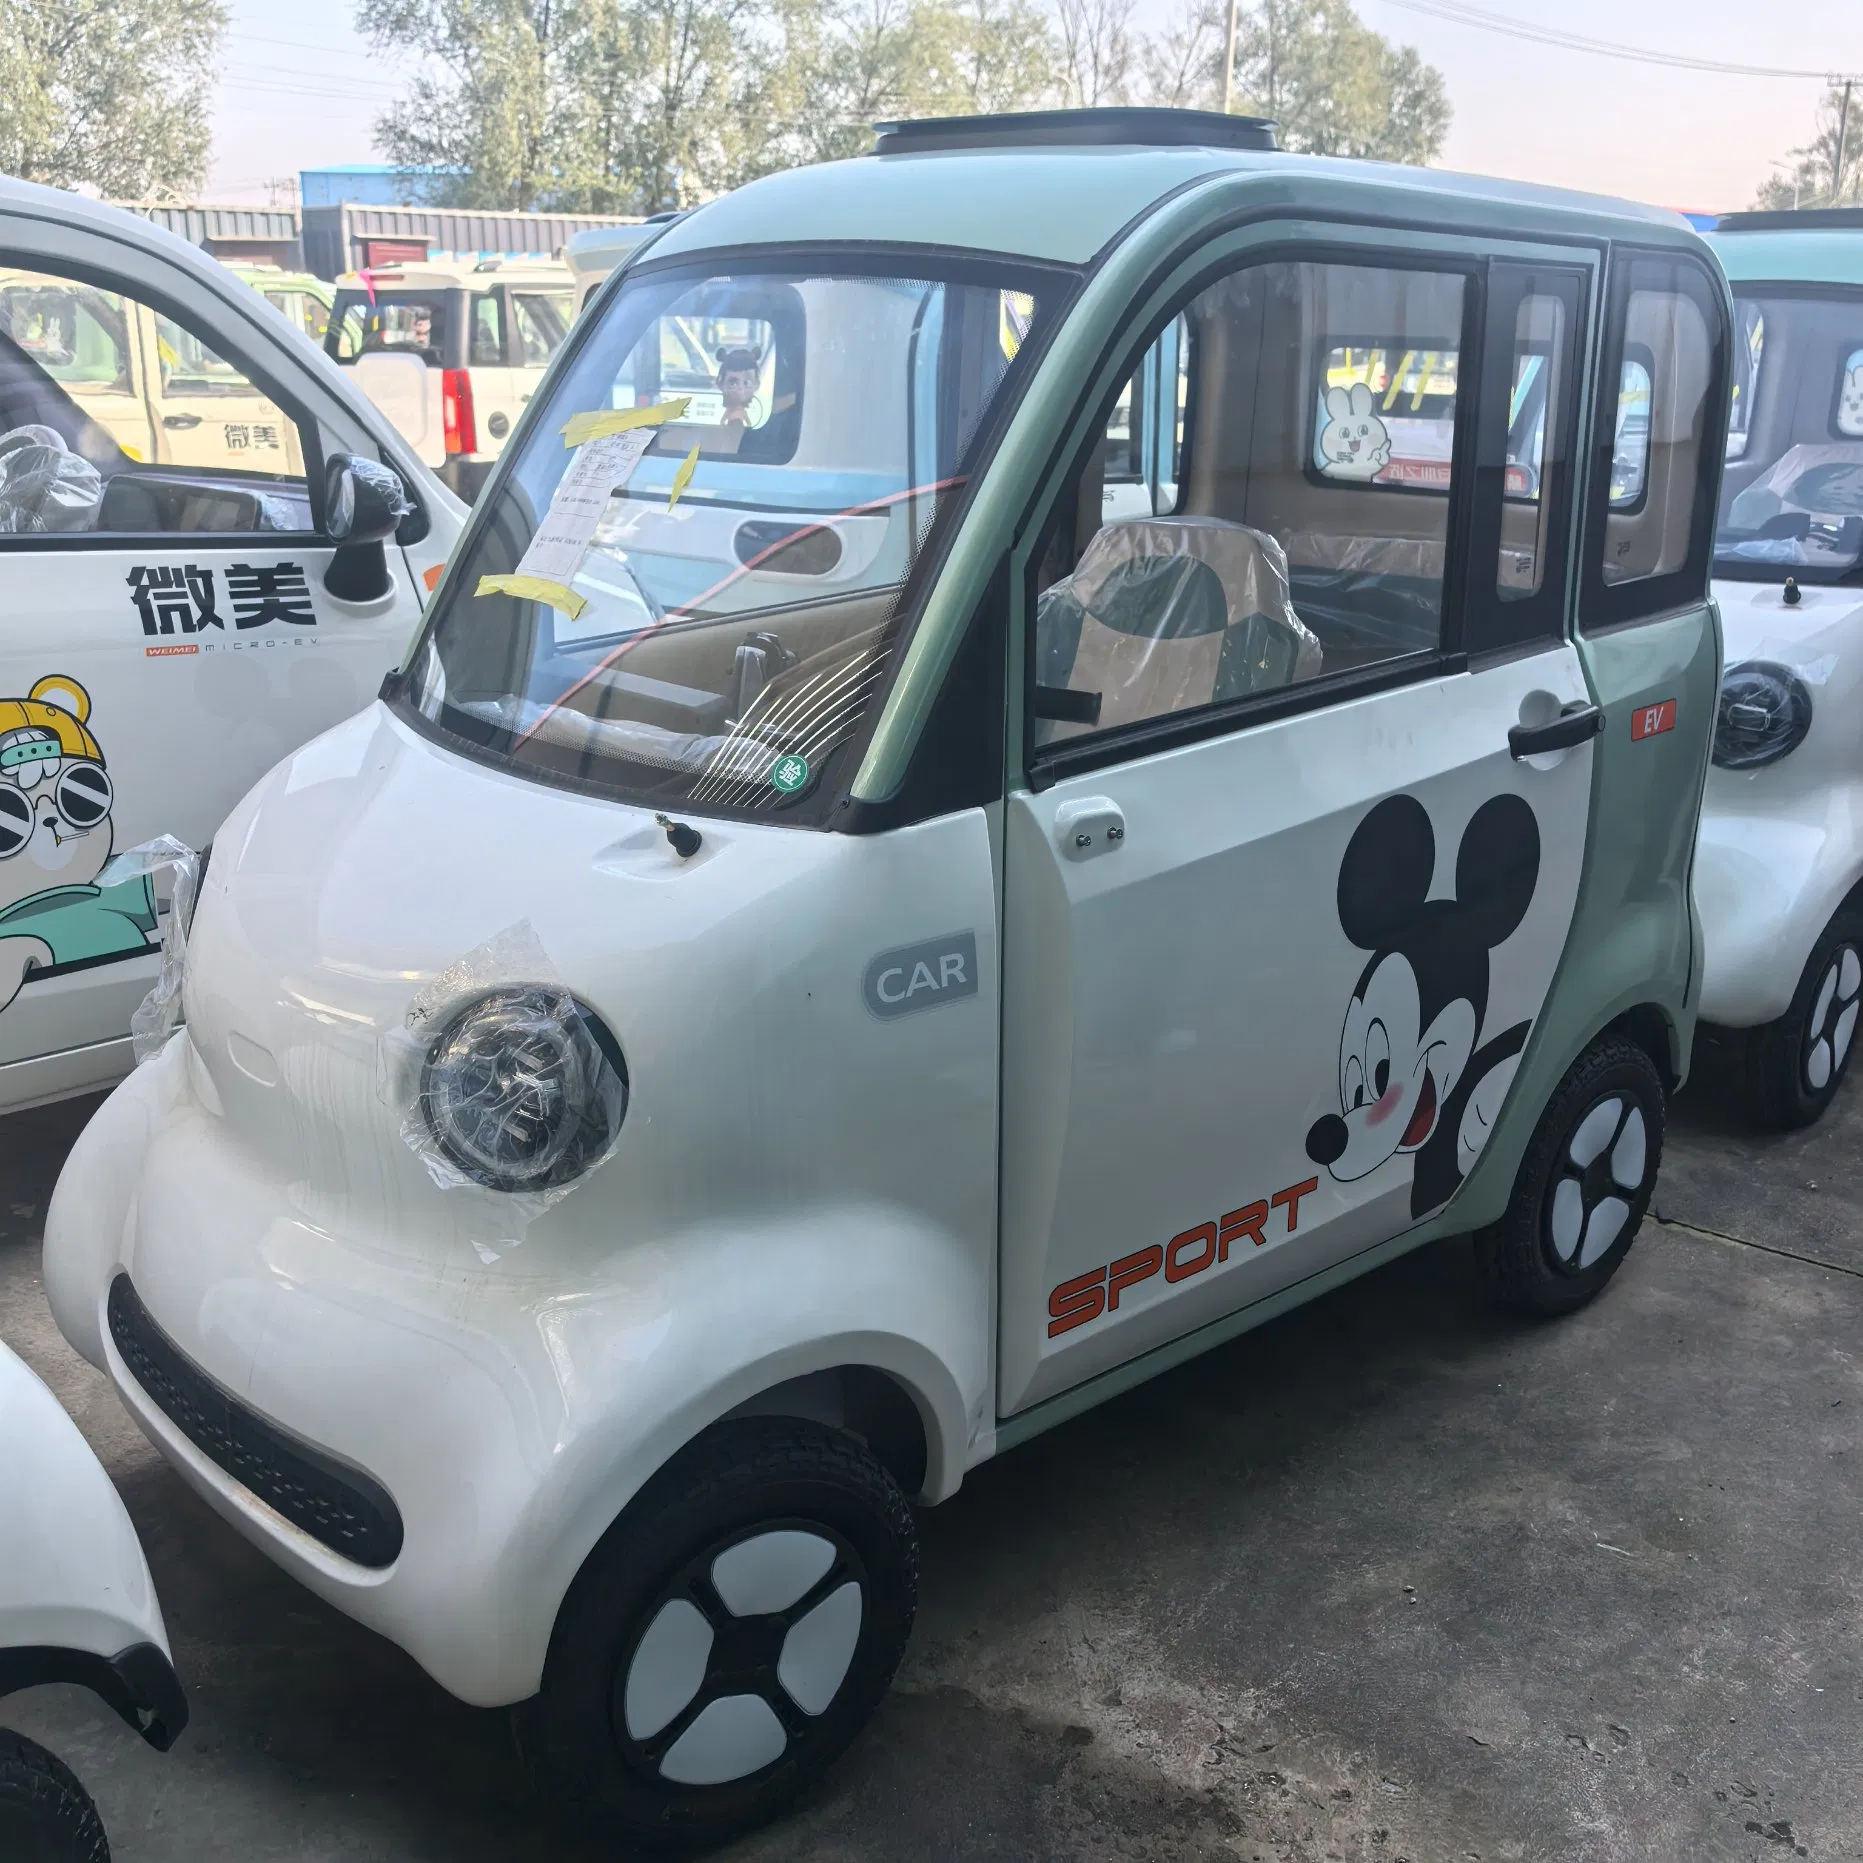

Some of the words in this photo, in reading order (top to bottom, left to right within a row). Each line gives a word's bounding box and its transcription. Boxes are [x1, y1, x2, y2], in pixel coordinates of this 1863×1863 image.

[224, 424, 279, 449] 微美
[126, 562, 317, 635] 微美
[147, 645, 198, 656] WEIMEI
[1644, 706, 1664, 733] EV
[778, 758, 802, 787] 验
[876, 952, 968, 1003] CAR
[1048, 1176, 1318, 1338] SPORT
